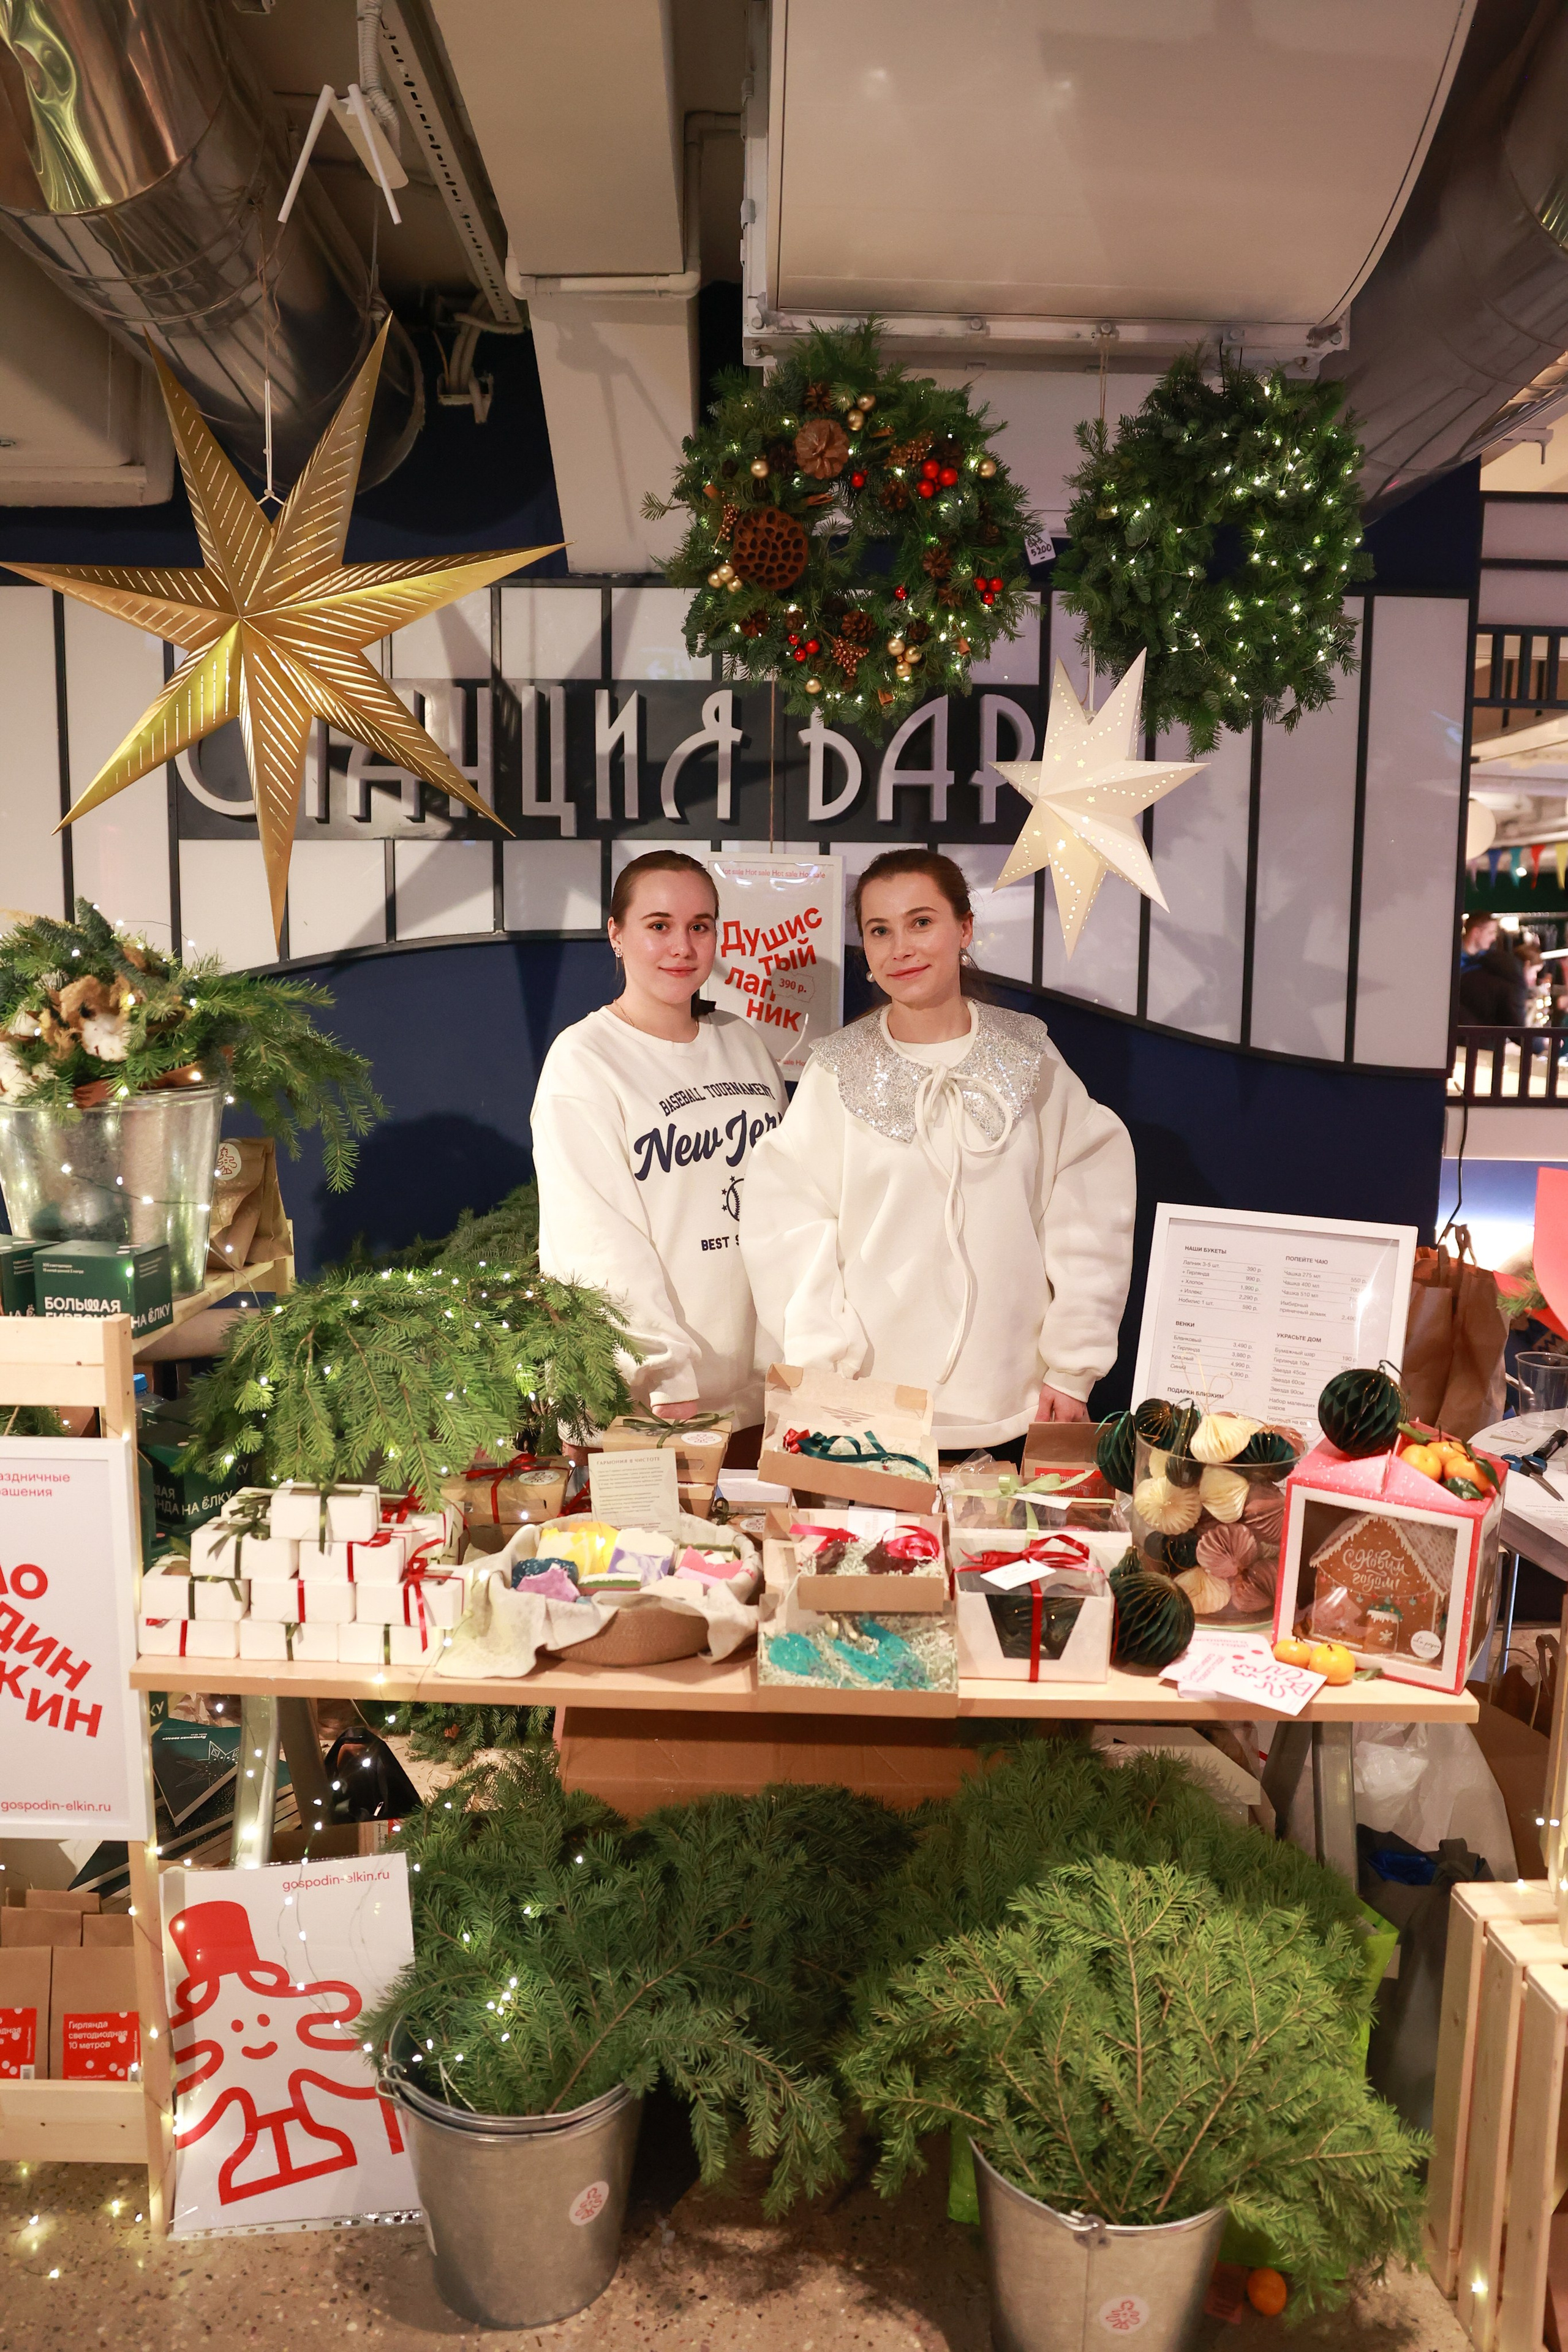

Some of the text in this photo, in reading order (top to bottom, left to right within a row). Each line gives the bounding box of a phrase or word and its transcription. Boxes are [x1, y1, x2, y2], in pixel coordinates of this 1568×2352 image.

[721, 907, 823, 958] Душис
[758, 937, 817, 977] тый
[779, 978, 796, 990] 390
[746, 998, 802, 1032] ник
[659, 1082, 776, 1117] BASEBALL TOURNAMENT
[634, 1109, 783, 1181] New Jer
[701, 1236, 729, 1251] BEST
[44, 1297, 121, 1313] БОЛЬШАЯ
[148, 1303, 171, 1323] ЁЛКУ
[1167, 1387, 1224, 1399] ПОДАРКИ БЛИЗКИМ
[0, 1487, 53, 1497] ашения
[182, 1502, 199, 1515] НА
[1343, 1548, 1355, 1566] С
[1, 1800, 111, 1812] gospodin-elkin.ru
[282, 1871, 390, 1892] gospodin-elkin.ru
[69, 2021, 108, 2030] Гирлянда
[69, 2030, 128, 2040] светодиодная
[79, 2041, 111, 2050] метров
